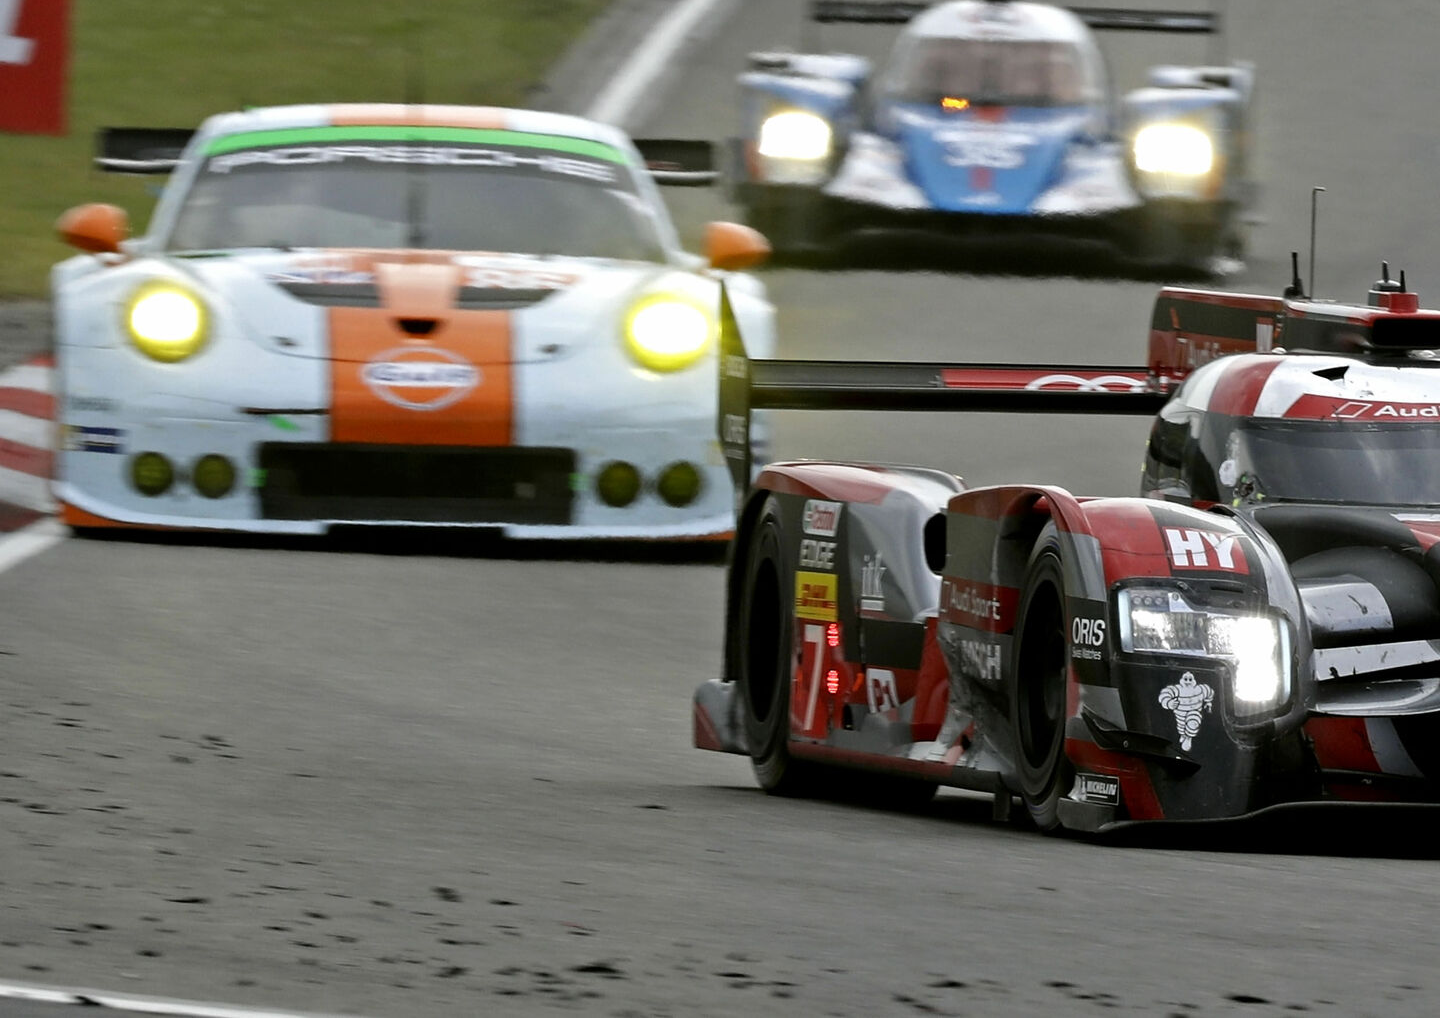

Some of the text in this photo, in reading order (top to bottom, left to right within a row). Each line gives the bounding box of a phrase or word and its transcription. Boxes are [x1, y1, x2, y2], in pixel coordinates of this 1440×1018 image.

[1165, 528, 1235, 569] HY
[1072, 616, 1106, 646] ORIS
[803, 624, 825, 731] 7
